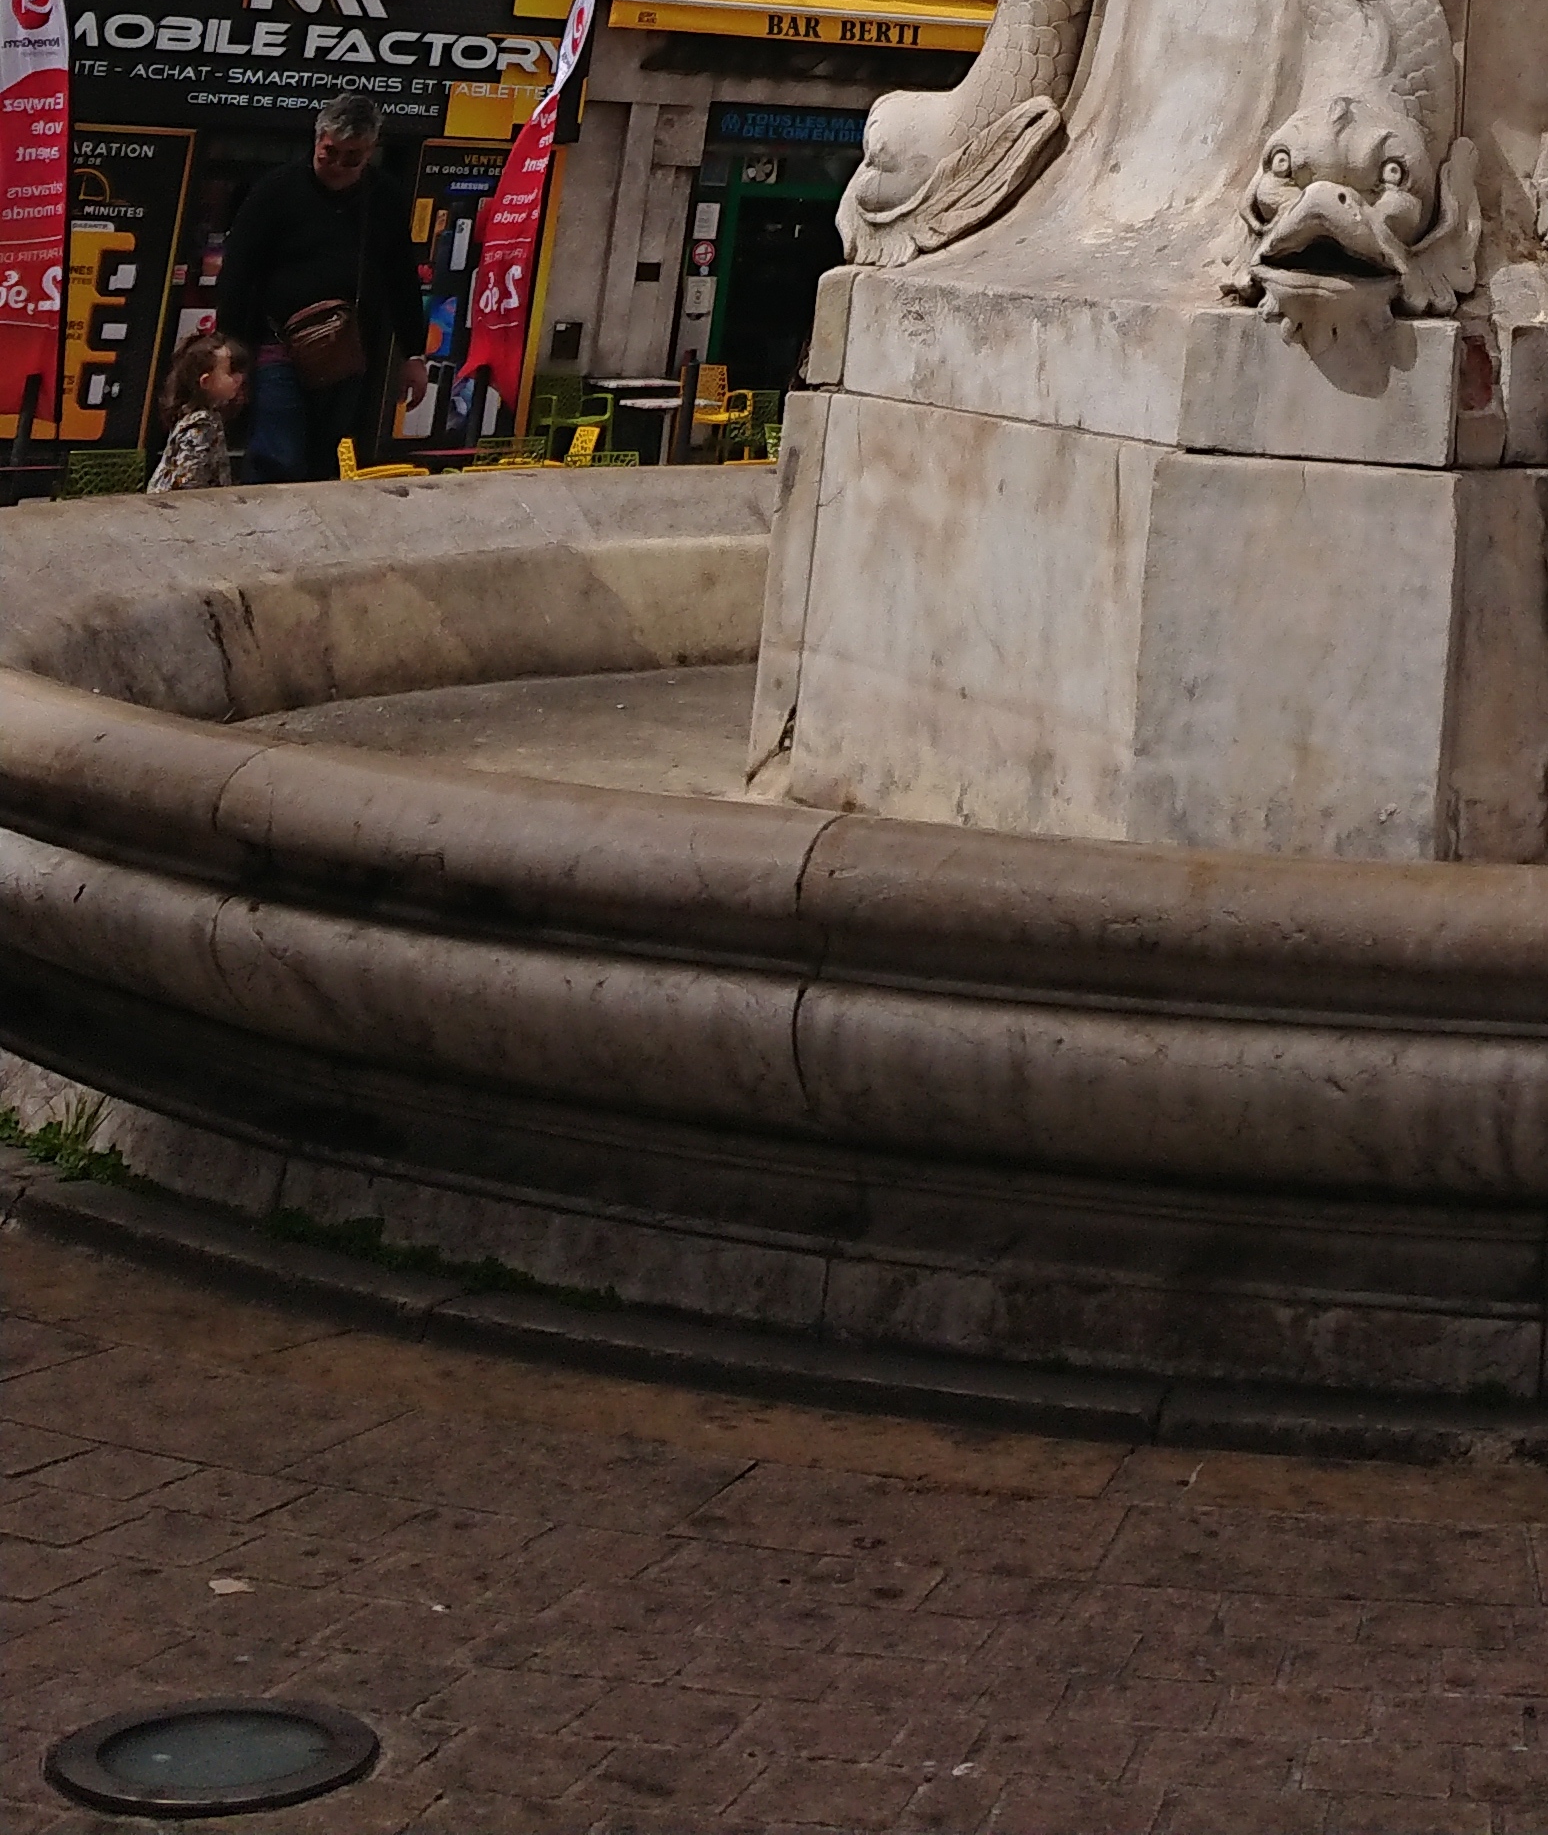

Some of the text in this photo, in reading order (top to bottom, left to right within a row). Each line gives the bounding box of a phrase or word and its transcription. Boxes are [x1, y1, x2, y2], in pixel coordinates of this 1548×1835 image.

[766, 13, 921, 47] BAR BERTI
[303, 25, 559, 74] FACTORY
[129, 63, 212, 82] ACHAT
[227, 67, 402, 93] SMARTPHONES
[411, 79, 437, 95] ET
[187, 91, 250, 107] CENTRE
[253, 95, 275, 108] DE
[381, 102, 440, 117] MOBILE
[425, 164, 440, 174] EN
[442, 165, 470, 175] GROS
[472, 167, 485, 176] ET
[464, 154, 504, 166] VENTE
[83, 205, 145, 218] MINUTES
